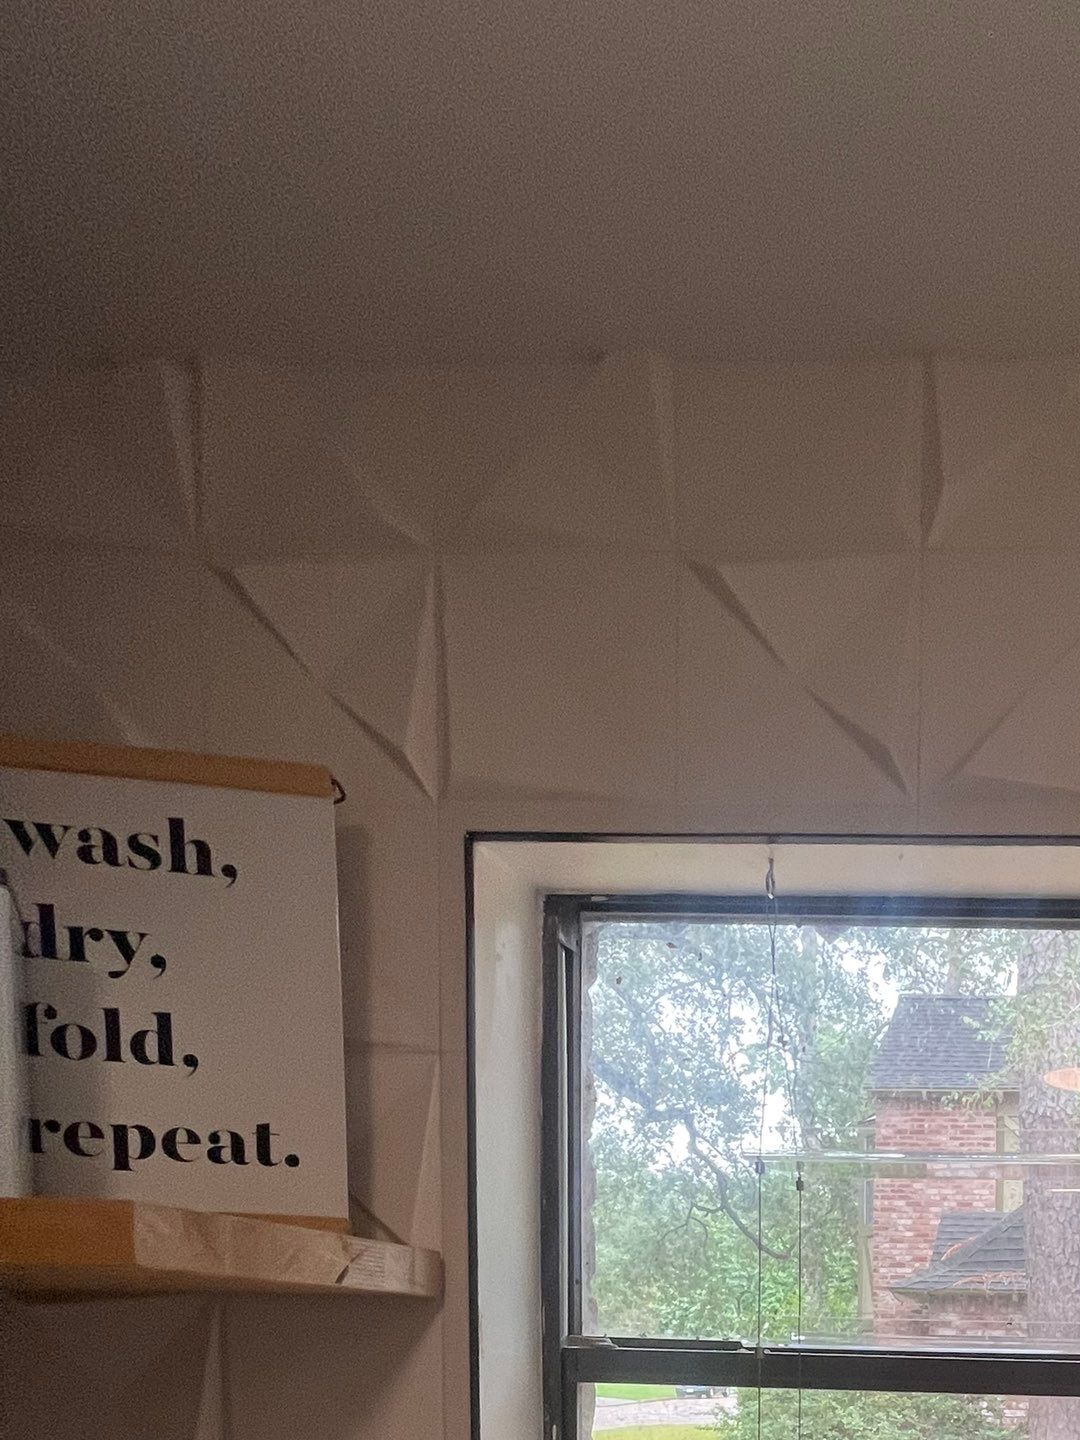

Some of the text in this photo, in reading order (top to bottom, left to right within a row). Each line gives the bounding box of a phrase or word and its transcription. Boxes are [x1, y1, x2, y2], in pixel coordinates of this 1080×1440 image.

[2, 816, 239, 889] wash,
[22, 902, 168, 980] dry,
[24, 1001, 200, 1078] fold,
[28, 1116, 301, 1172] repeat.
